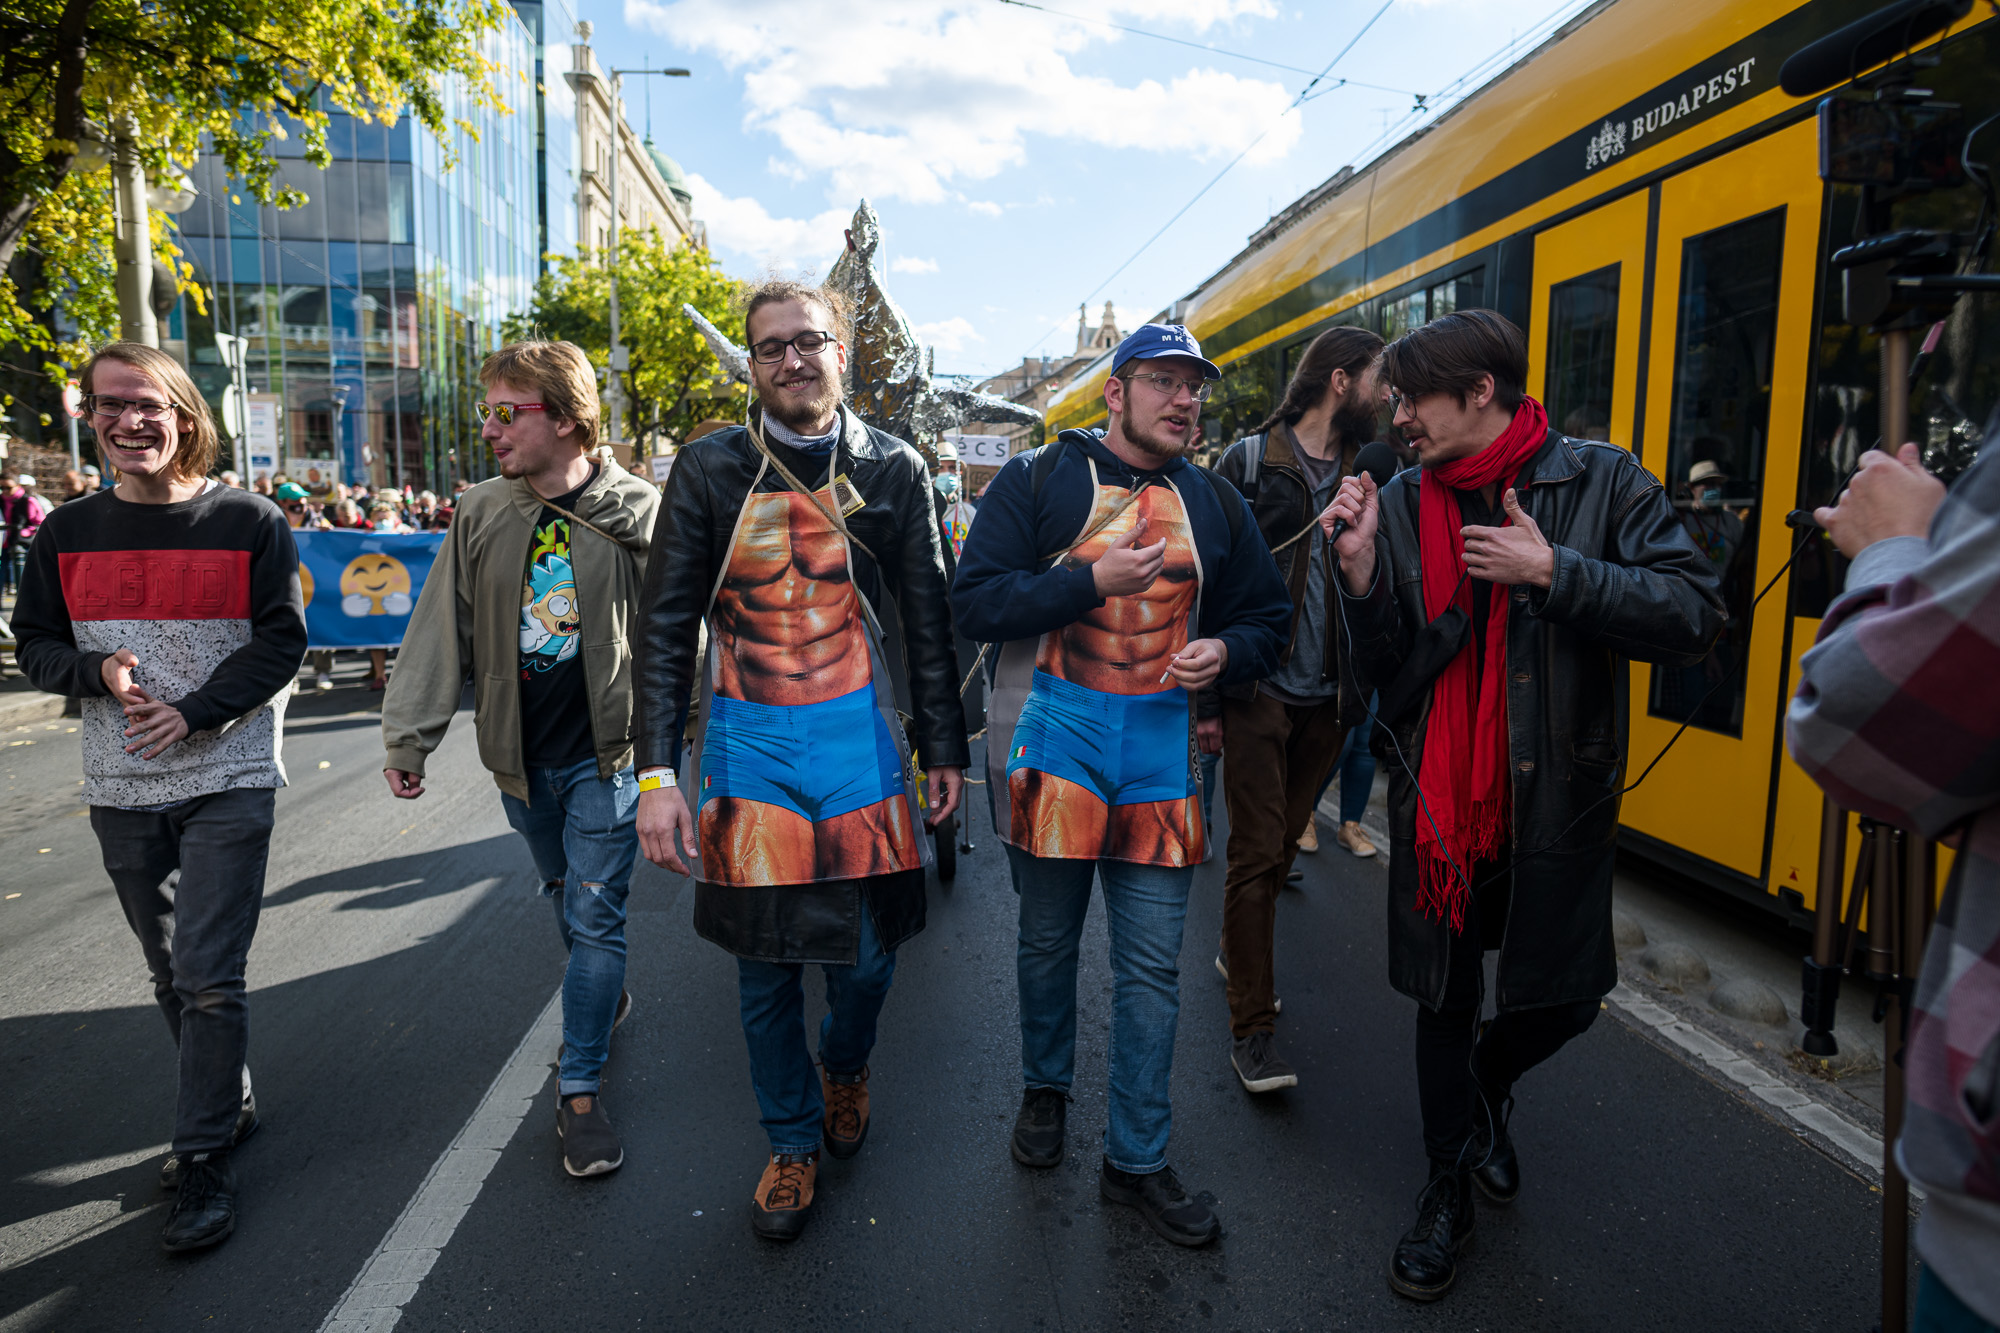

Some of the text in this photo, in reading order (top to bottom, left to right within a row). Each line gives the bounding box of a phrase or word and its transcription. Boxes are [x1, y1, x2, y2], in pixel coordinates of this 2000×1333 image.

[1631, 57, 1756, 141] BUDAPEST
[77, 560, 228, 608] LGND
[1190, 714, 1202, 783] MACHO
